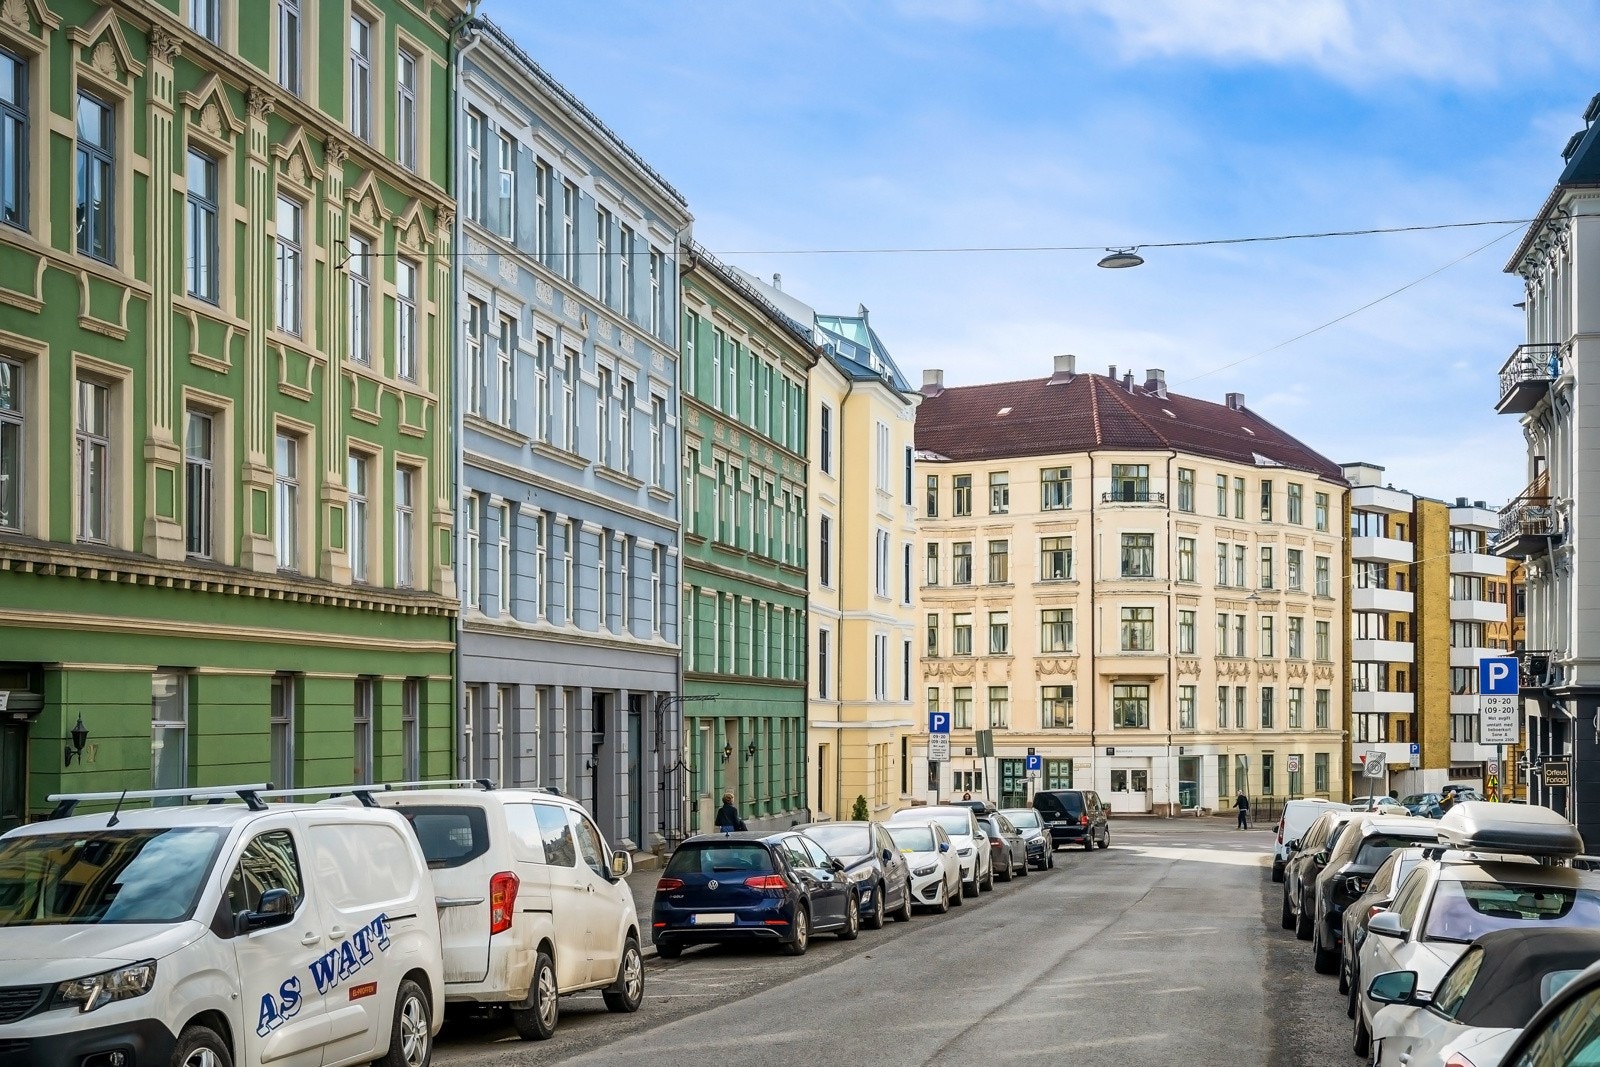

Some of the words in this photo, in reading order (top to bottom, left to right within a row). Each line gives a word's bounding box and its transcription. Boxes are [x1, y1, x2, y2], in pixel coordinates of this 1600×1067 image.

[1489, 662, 1509, 690] P
[934, 714, 946, 731] P
[1412, 744, 1418, 753] P
[1029, 757, 1037, 768] P
[1546, 776, 1567, 784] Forlag
[256, 976, 303, 1038] AS
[308, 912, 391, 995] WATT
